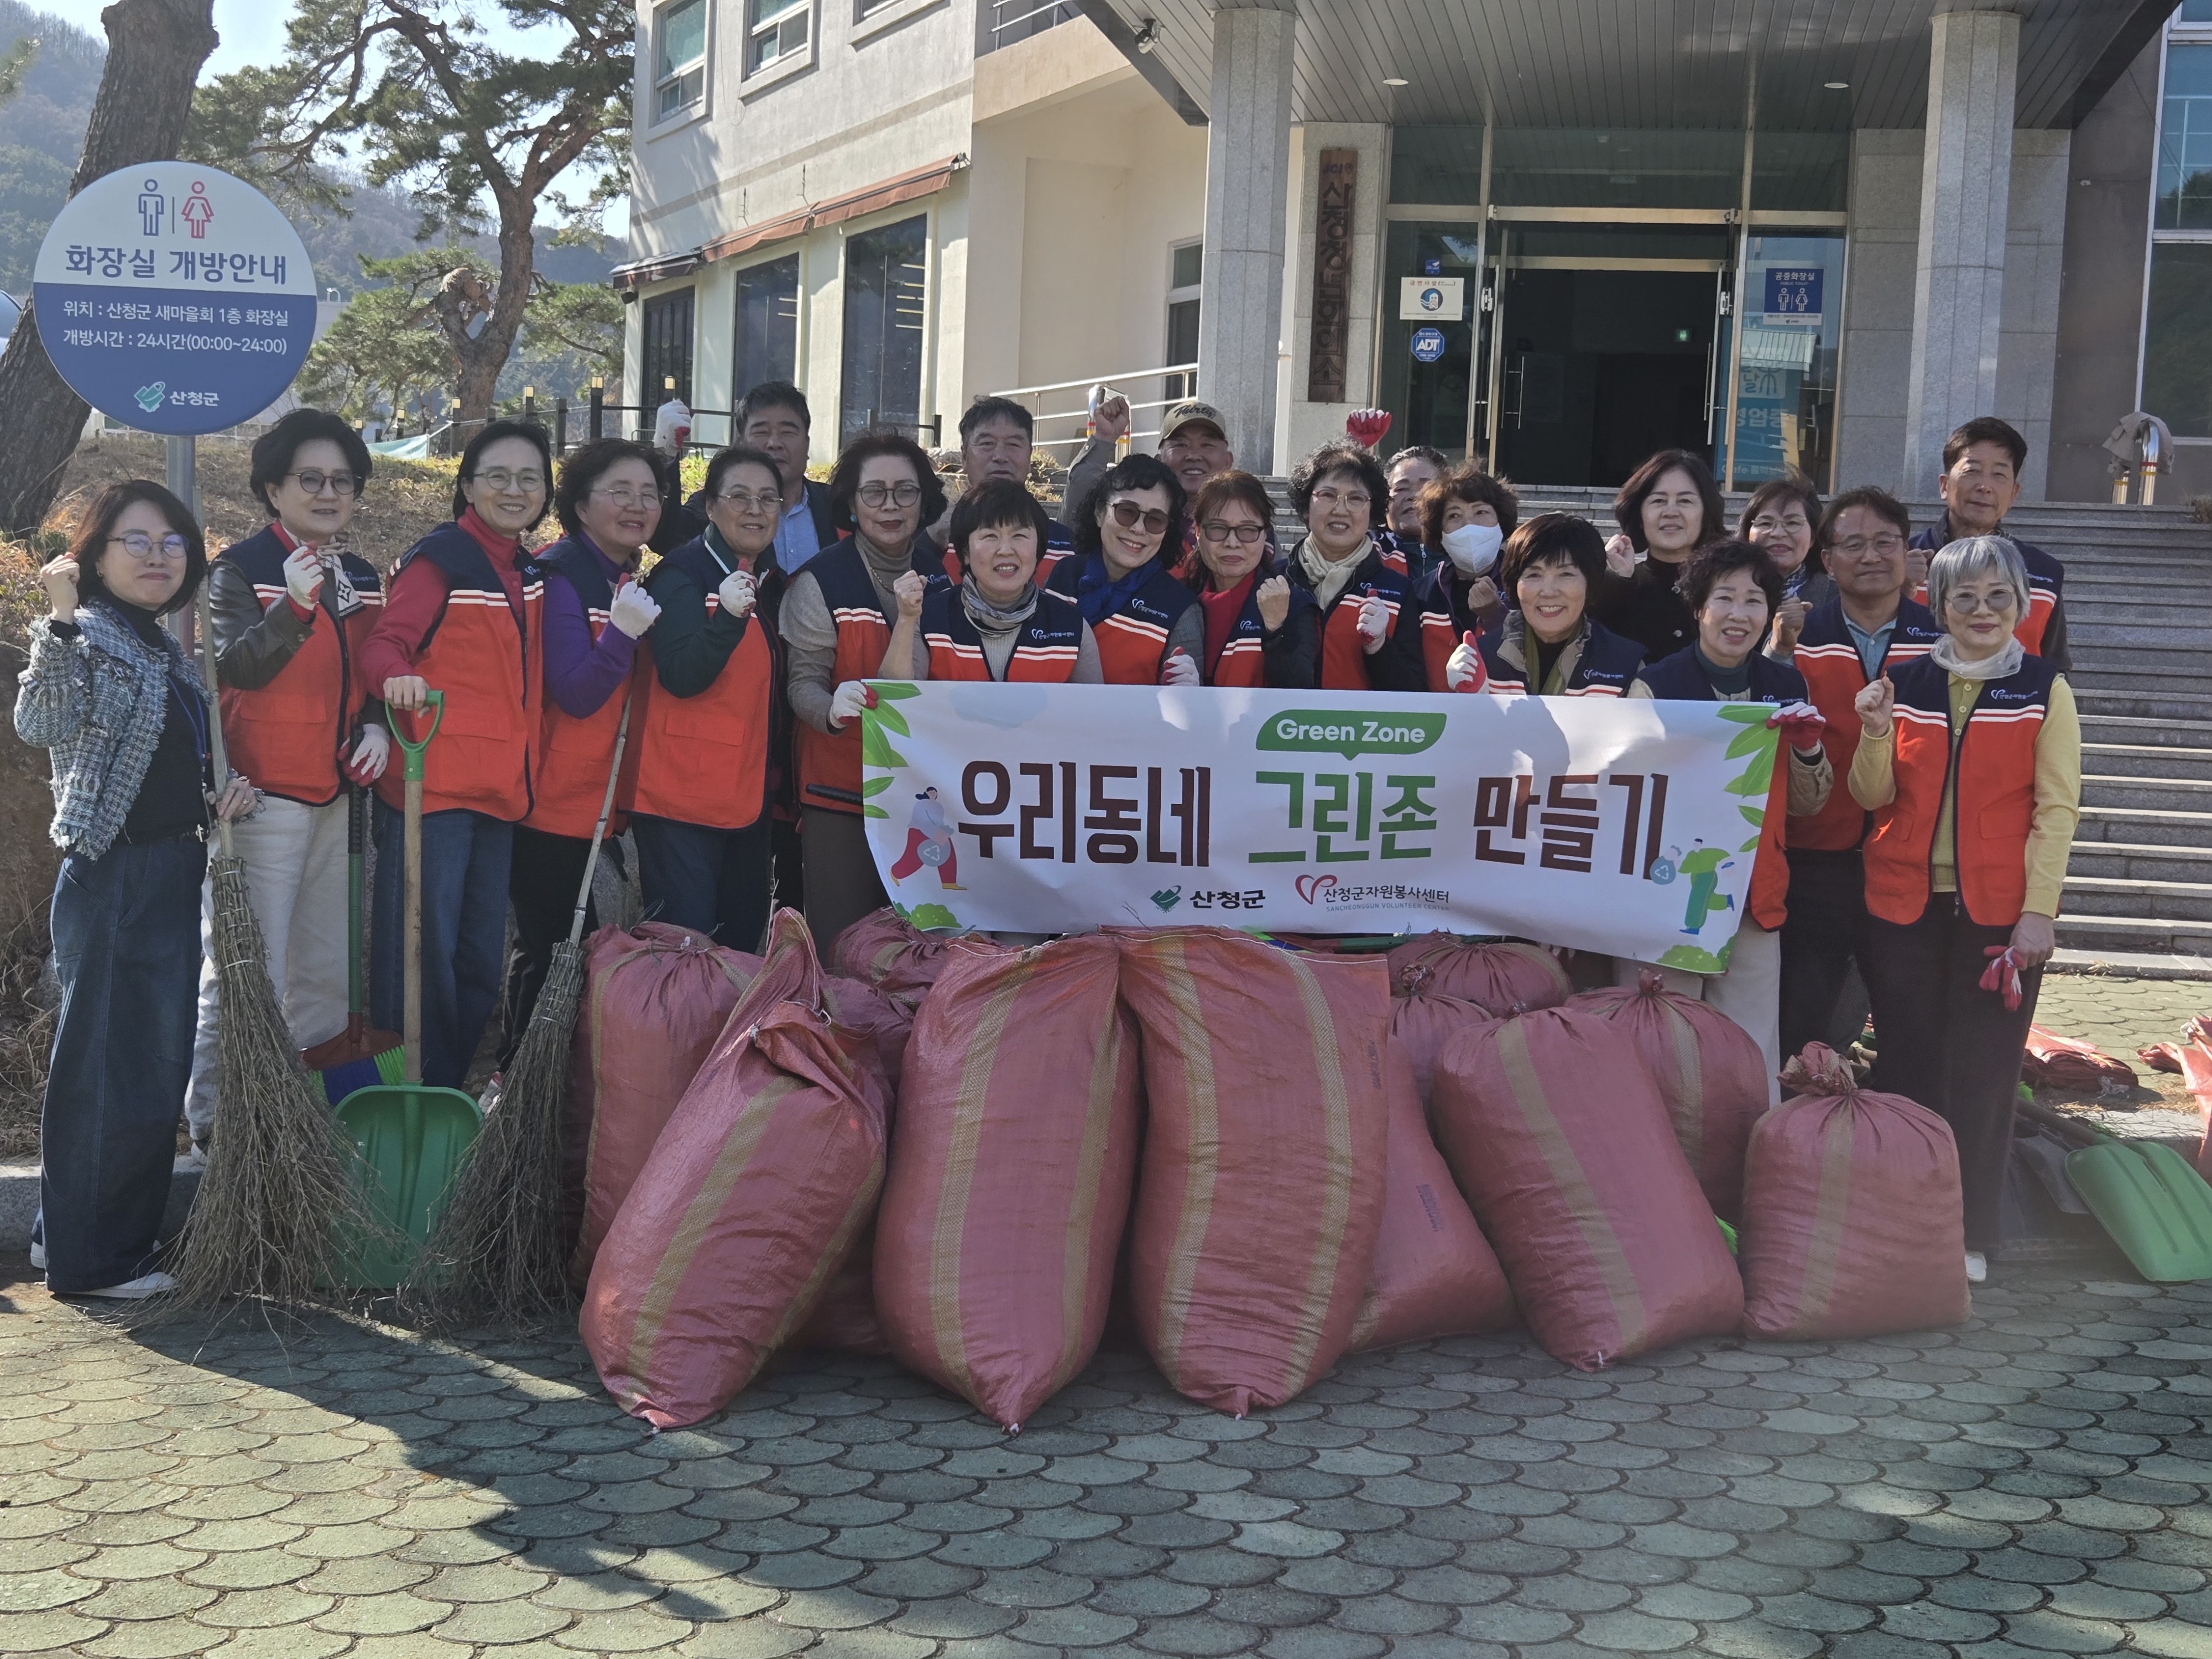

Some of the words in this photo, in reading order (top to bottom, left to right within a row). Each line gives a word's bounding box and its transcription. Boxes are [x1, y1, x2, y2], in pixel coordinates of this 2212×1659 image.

[65, 245, 155, 279] 화장실
[169, 250, 286, 285] 개방안내
[1775, 272, 1815, 281] 공중화장실
[64, 301, 93, 318] 위치
[98, 304, 102, 315] :
[106, 302, 151, 321] 산청군
[155, 305, 213, 324] 새마을회
[219, 309, 242, 325] 1층
[245, 309, 289, 327] 화장실
[64, 330, 123, 348] 개방시간
[128, 335, 133, 346] :
[137, 332, 287, 355] 24시간(00:00~24:00)
[1416, 338, 1440, 351] ADT
[169, 390, 220, 406] 산청군
[1277, 719, 1355, 742] Green
[1361, 721, 1426, 743] Zone
[958, 760, 1211, 867] 우리동네
[1248, 770, 1437, 864] 그린존
[1473, 773, 1668, 880] 만들기
[1190, 889, 1266, 909] 산청군
[1323, 885, 1449, 904] 산청군자원봉사센터
[1326, 902, 1379, 912] SANCHEONGGUN
